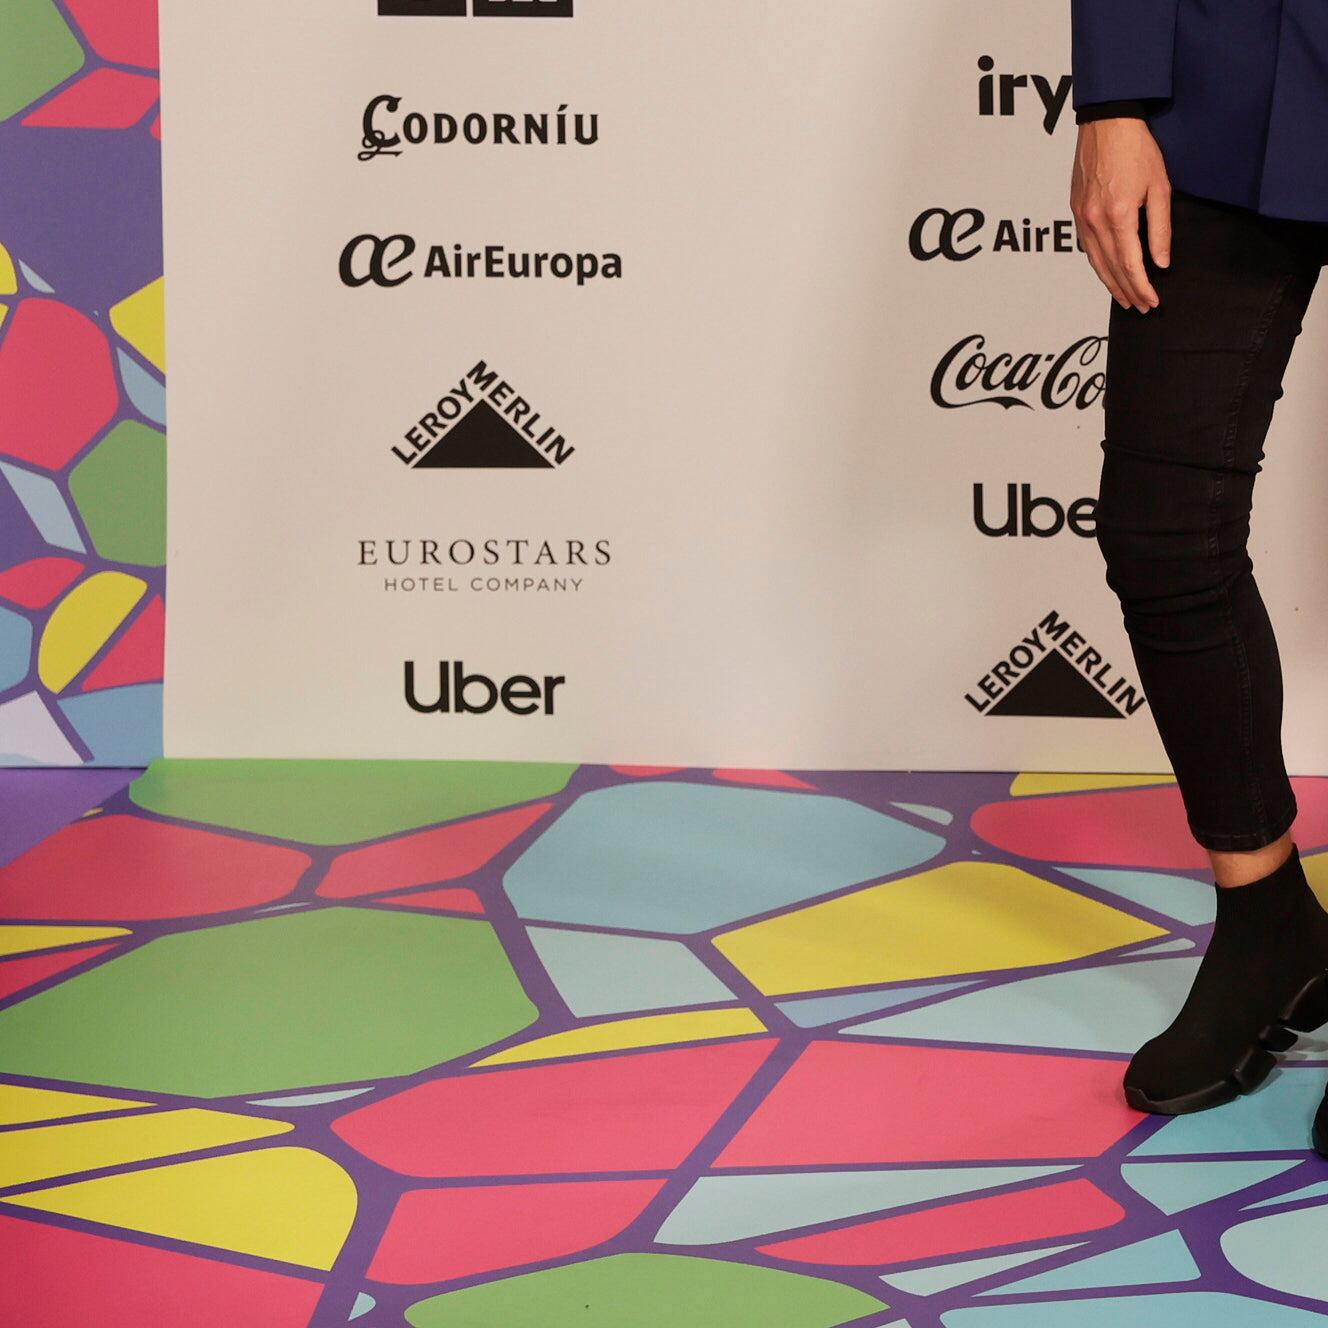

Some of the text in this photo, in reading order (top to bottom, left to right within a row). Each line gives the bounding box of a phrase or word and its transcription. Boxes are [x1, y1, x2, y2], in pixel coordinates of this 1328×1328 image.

[978, 55, 1073, 136] iry
[930, 334, 1108, 410] Coca-Co
[391, 360, 576, 466] LEROY MERLIN
[973, 483, 1099, 538] Ube
[357, 538, 611, 566] EUROSTARS
[384, 577, 583, 592] HOTEL COMPANY
[403, 660, 565, 716] Uber
[964, 610, 1146, 716] LEROY MERLIN
